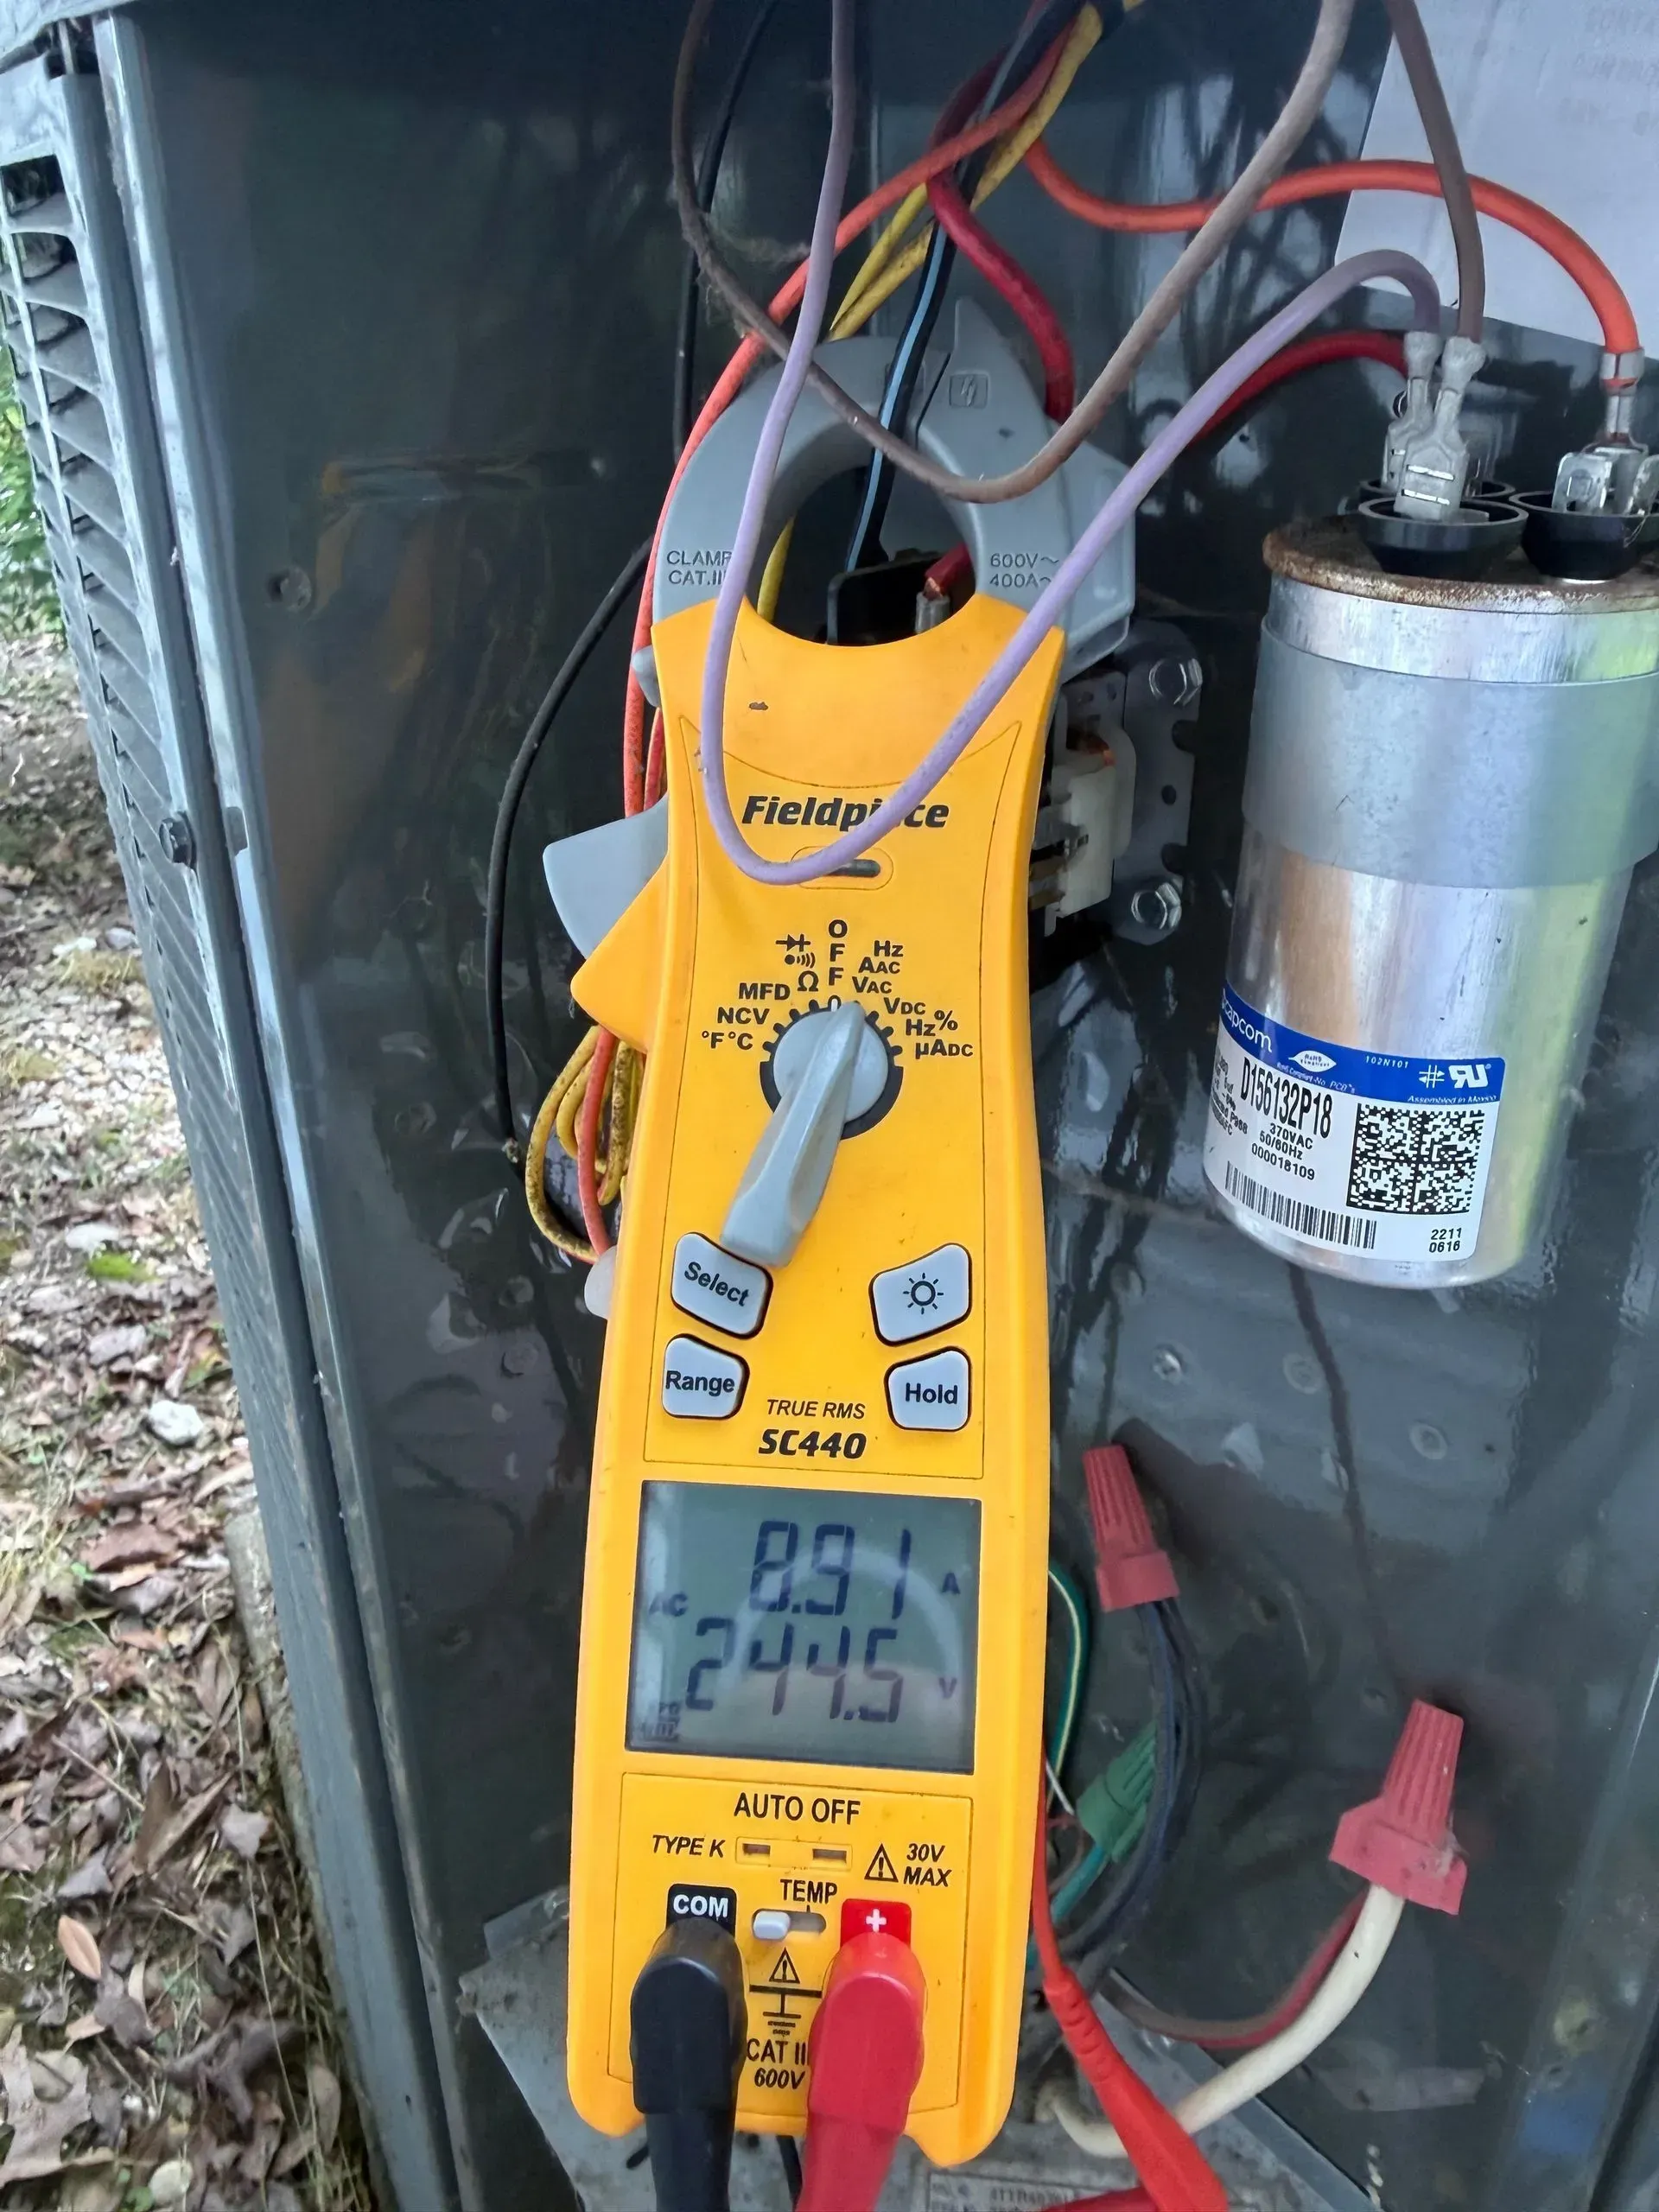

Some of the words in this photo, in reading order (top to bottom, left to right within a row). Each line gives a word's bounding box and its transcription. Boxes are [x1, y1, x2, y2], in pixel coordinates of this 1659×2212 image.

[741, 795, 950, 832] Fieldpice
[874, 940, 904, 958] Hz
[738, 982, 791, 1001] MFD
[717, 1007, 770, 1025] NCV
[1365, 1054, 1408, 1069] 102N101
[1240, 1056, 1332, 1139] D156132P18
[1259, 1130, 1303, 1160] 50/60Hz
[1269, 1122, 1313, 1150] 370VAC
[1251, 1142, 1315, 1181] 000018109
[1430, 1227, 1462, 1241] 2211
[683, 1261, 750, 1307] Select
[665, 1370, 735, 1397] Range
[905, 1382, 958, 1405] Hold
[767, 1399, 818, 1418] TRUE
[823, 1402, 866, 1420] RMS
[758, 1428, 867, 1459] SC440
[748, 1520, 912, 1620] 8.91
[941, 1572, 961, 1595] A
[685, 1617, 904, 1724] 244.5
[734, 1792, 804, 1821] AUTO
[810, 1797, 861, 1825] OFF
[652, 1834, 705, 1856] TYPE
[709, 1839, 726, 1858] K
[906, 1843, 945, 1863] 30V
[903, 1866, 952, 1887] MAX
[779, 1878, 838, 1904] TEMP
[673, 1894, 729, 1918] COM
[747, 2037, 788, 2064] CAT
[754, 2068, 805, 2089] 600V
